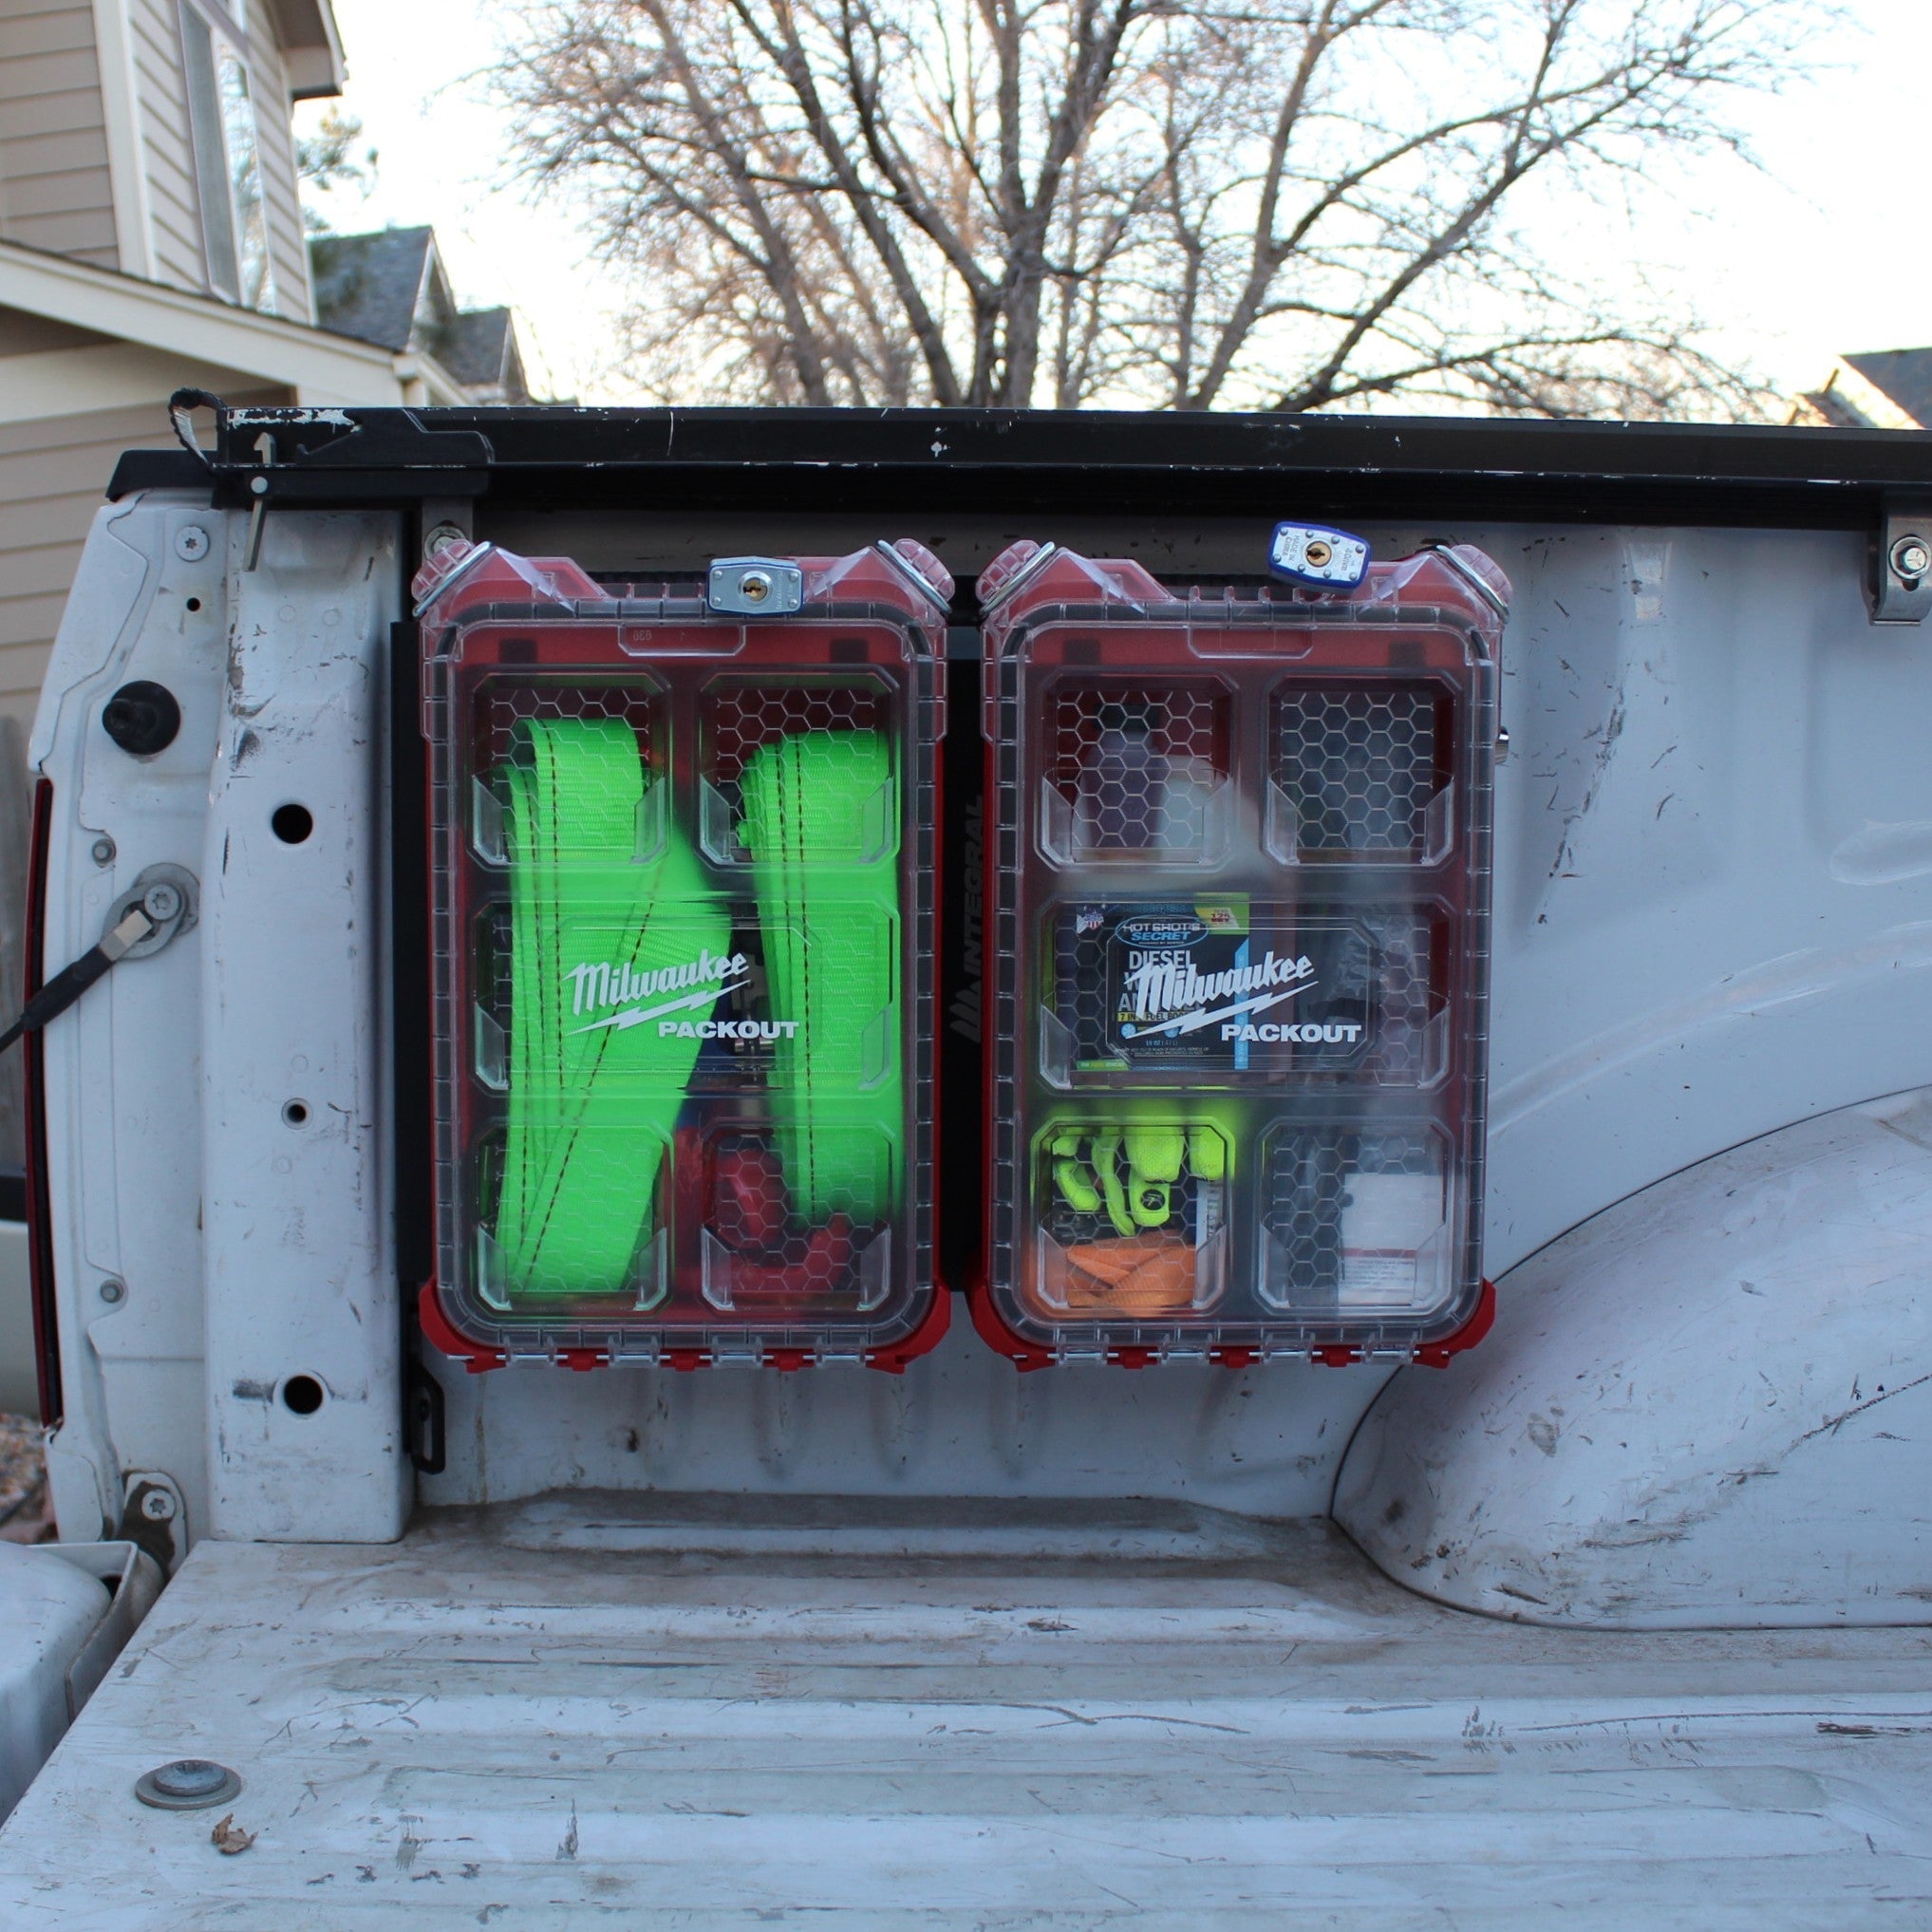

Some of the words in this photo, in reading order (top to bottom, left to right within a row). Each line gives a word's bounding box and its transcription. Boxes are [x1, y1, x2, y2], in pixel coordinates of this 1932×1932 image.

[964, 794, 984, 977] INTEGRAL
[1123, 923, 1152, 932] HOT
[1131, 931, 1191, 941] SECRET
[562, 948, 750, 1014] Milwaukee
[1123, 951, 1315, 1019] Milwaukee
[658, 1021, 799, 1039] PACKOUT
[1221, 1023, 1362, 1042] PACKOUT
